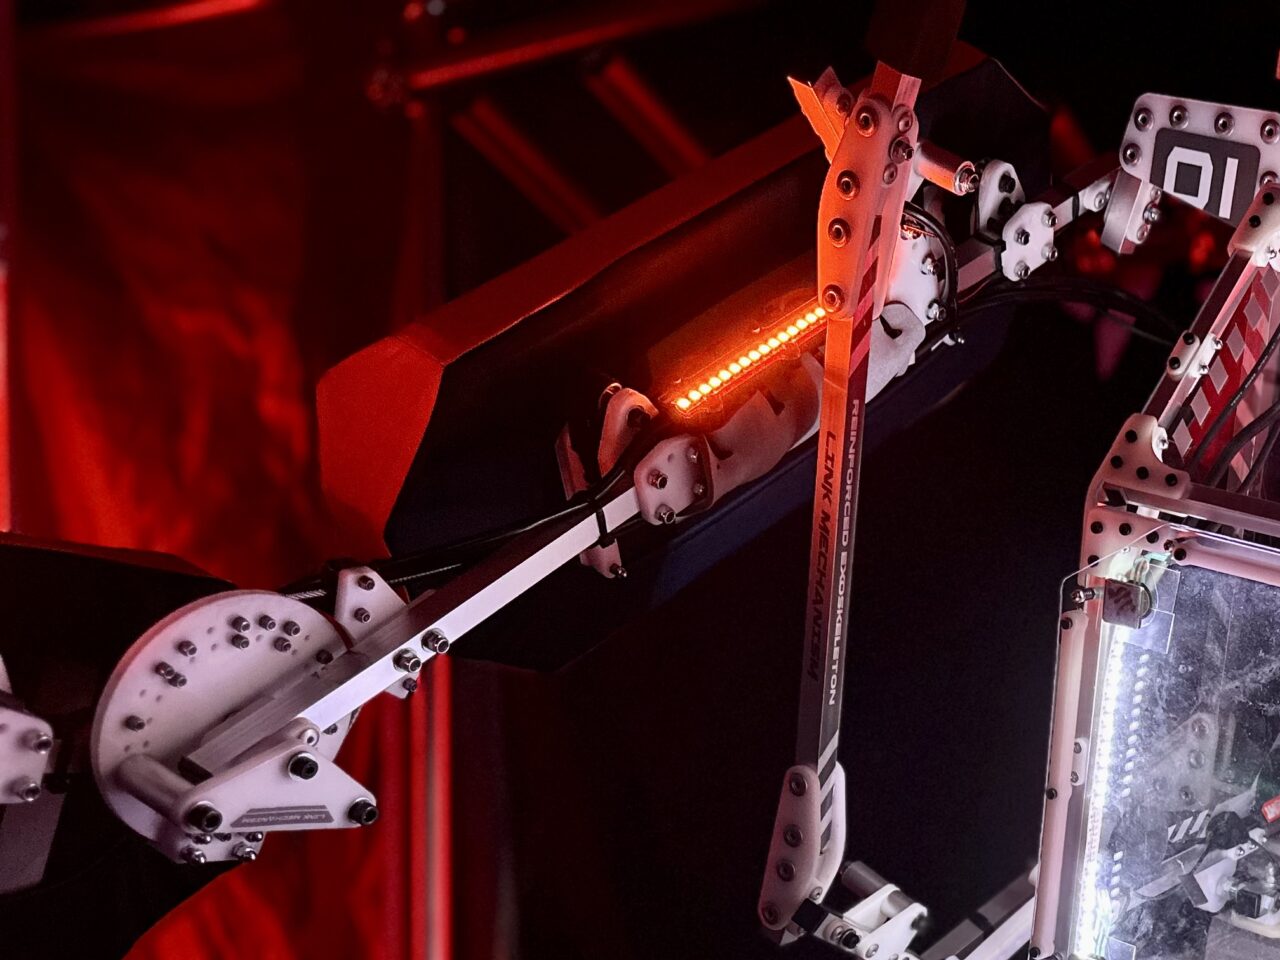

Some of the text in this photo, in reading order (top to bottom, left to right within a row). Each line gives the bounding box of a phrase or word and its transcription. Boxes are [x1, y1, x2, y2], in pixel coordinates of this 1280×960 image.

[807, 430, 837, 681] LINK MECHANISM
[828, 399, 860, 706] REINFORCED EXOSKELETON
